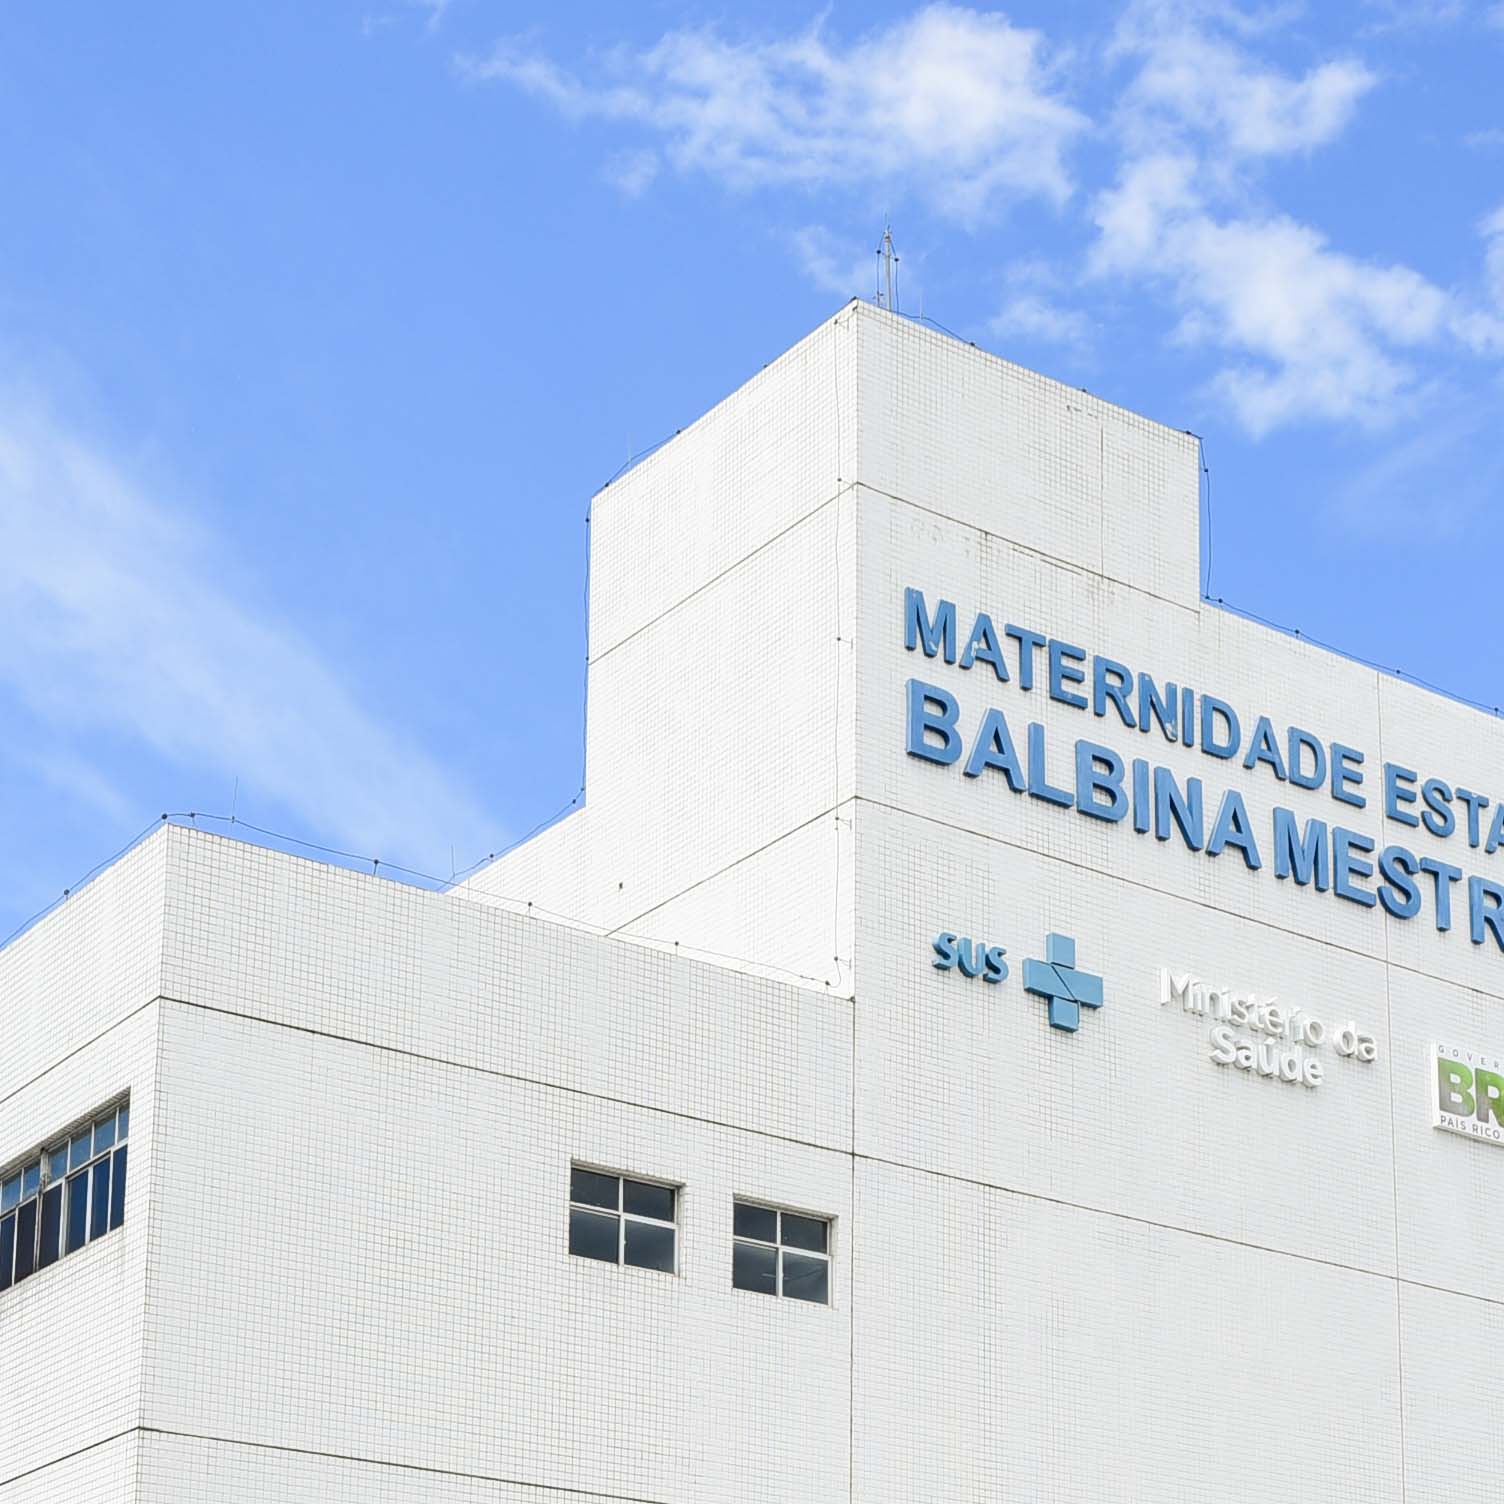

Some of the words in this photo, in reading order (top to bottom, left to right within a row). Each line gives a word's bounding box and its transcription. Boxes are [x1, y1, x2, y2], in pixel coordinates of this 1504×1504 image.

[904, 587, 1365, 806] MATERNIDADE
[905, 678, 1262, 870] BALBINA
[932, 932, 1009, 984] SUS
[1160, 967, 1325, 1047] Ministério
[1332, 1021, 1378, 1062] da
[1209, 1025, 1324, 1088] Saúde
[1440, 1114, 1466, 1131] PAÍS
[1472, 1124, 1500, 1140] RICO
